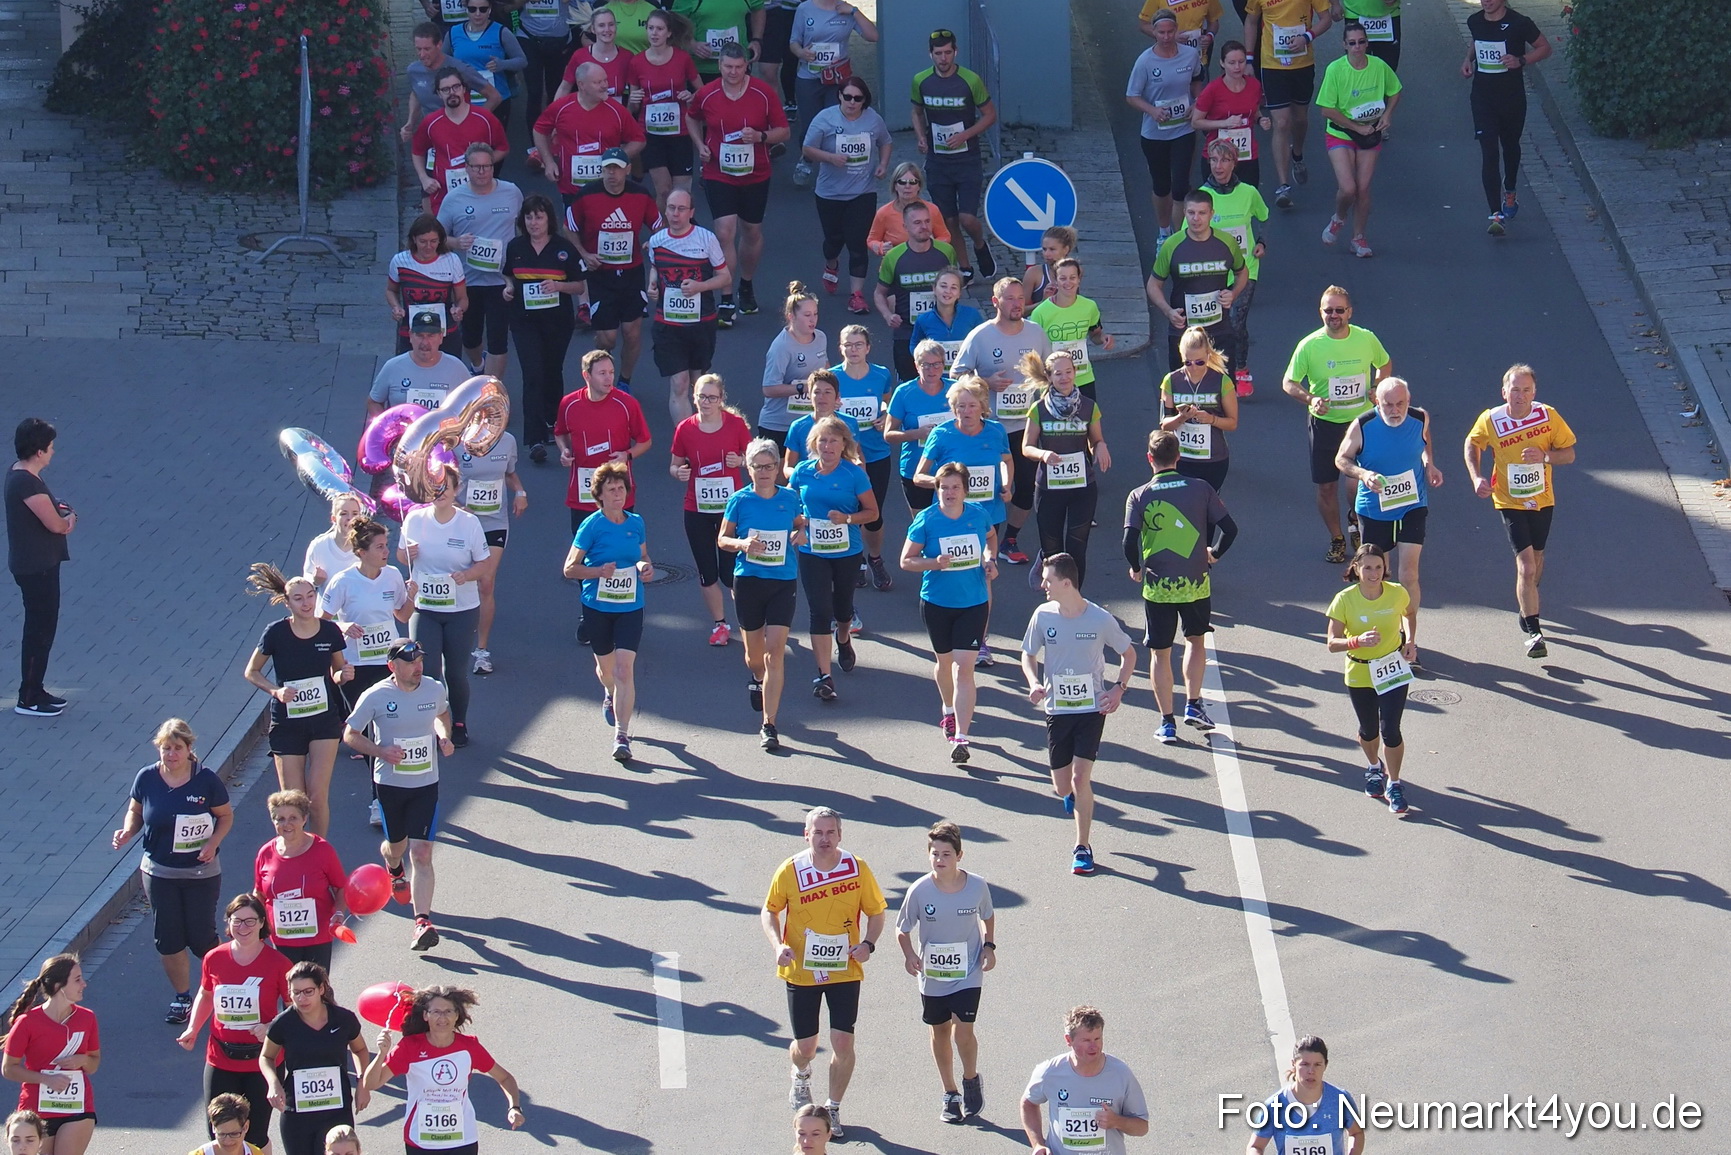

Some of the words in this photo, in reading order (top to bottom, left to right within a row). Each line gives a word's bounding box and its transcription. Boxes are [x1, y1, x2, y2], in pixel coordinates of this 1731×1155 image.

[1364, 20, 1387, 30] 5206
[813, 52, 835, 62] 057
[1479, 50, 1501, 60] 5183
[923, 96, 966, 107] BOCK
[1168, 103, 1186, 117] 199
[651, 111, 675, 122] 5126
[841, 143, 866, 153] 5098
[724, 153, 750, 164] 5117
[577, 164, 602, 175] 5113
[601, 220, 632, 229] adidas
[471, 244, 498, 258] 5207
[604, 240, 628, 251] 5132
[1178, 260, 1228, 274] BOCK
[900, 271, 939, 285] BOC
[669, 297, 695, 309] 5005
[915, 300, 936, 312] 514
[1191, 300, 1217, 313] 5146
[1334, 382, 1361, 396] 5217
[1002, 393, 1027, 405] 5033
[1173, 393, 1218, 404] BOCK
[845, 406, 873, 418] 5042
[1041, 421, 1088, 432] BOCK
[1180, 431, 1205, 445] 5143
[1500, 434, 1523, 449] MAX
[1527, 425, 1552, 440] BÖGL
[1053, 462, 1080, 475] 5145
[969, 476, 990, 488] 038
[1514, 470, 1540, 485] 5088
[1151, 480, 1189, 491] BOCK
[1384, 480, 1412, 496] 5208
[472, 489, 498, 501] 5218
[701, 487, 729, 500] 5115
[815, 528, 843, 540] 5035
[760, 540, 782, 552] 039
[947, 544, 975, 557] 5041
[422, 583, 450, 595] 5103
[605, 577, 632, 589] 5040
[362, 631, 391, 646] 5102
[1376, 660, 1402, 678] 5151
[292, 687, 321, 703] 5082
[1059, 683, 1088, 696] 5154
[402, 746, 428, 759] 5198
[186, 795, 199, 803] vhs
[181, 824, 209, 838] 5137
[800, 890, 828, 905] MAX
[832, 881, 861, 896] BÖGL
[279, 910, 310, 923] 5127
[286, 927, 306, 935] Christa
[811, 944, 844, 957] 5097
[930, 953, 961, 966] 5045
[220, 996, 253, 1009] 5174
[46, 1082, 79, 1096] 575
[301, 1079, 335, 1094] 5034
[51, 1101, 73, 1109] Sabrina
[308, 1098, 331, 1107] Melanie
[425, 1113, 458, 1127] 5166
[1066, 1119, 1099, 1133] 5219
[430, 1133, 452, 1141] Claudia
[1292, 1146, 1327, 1155] 5169
